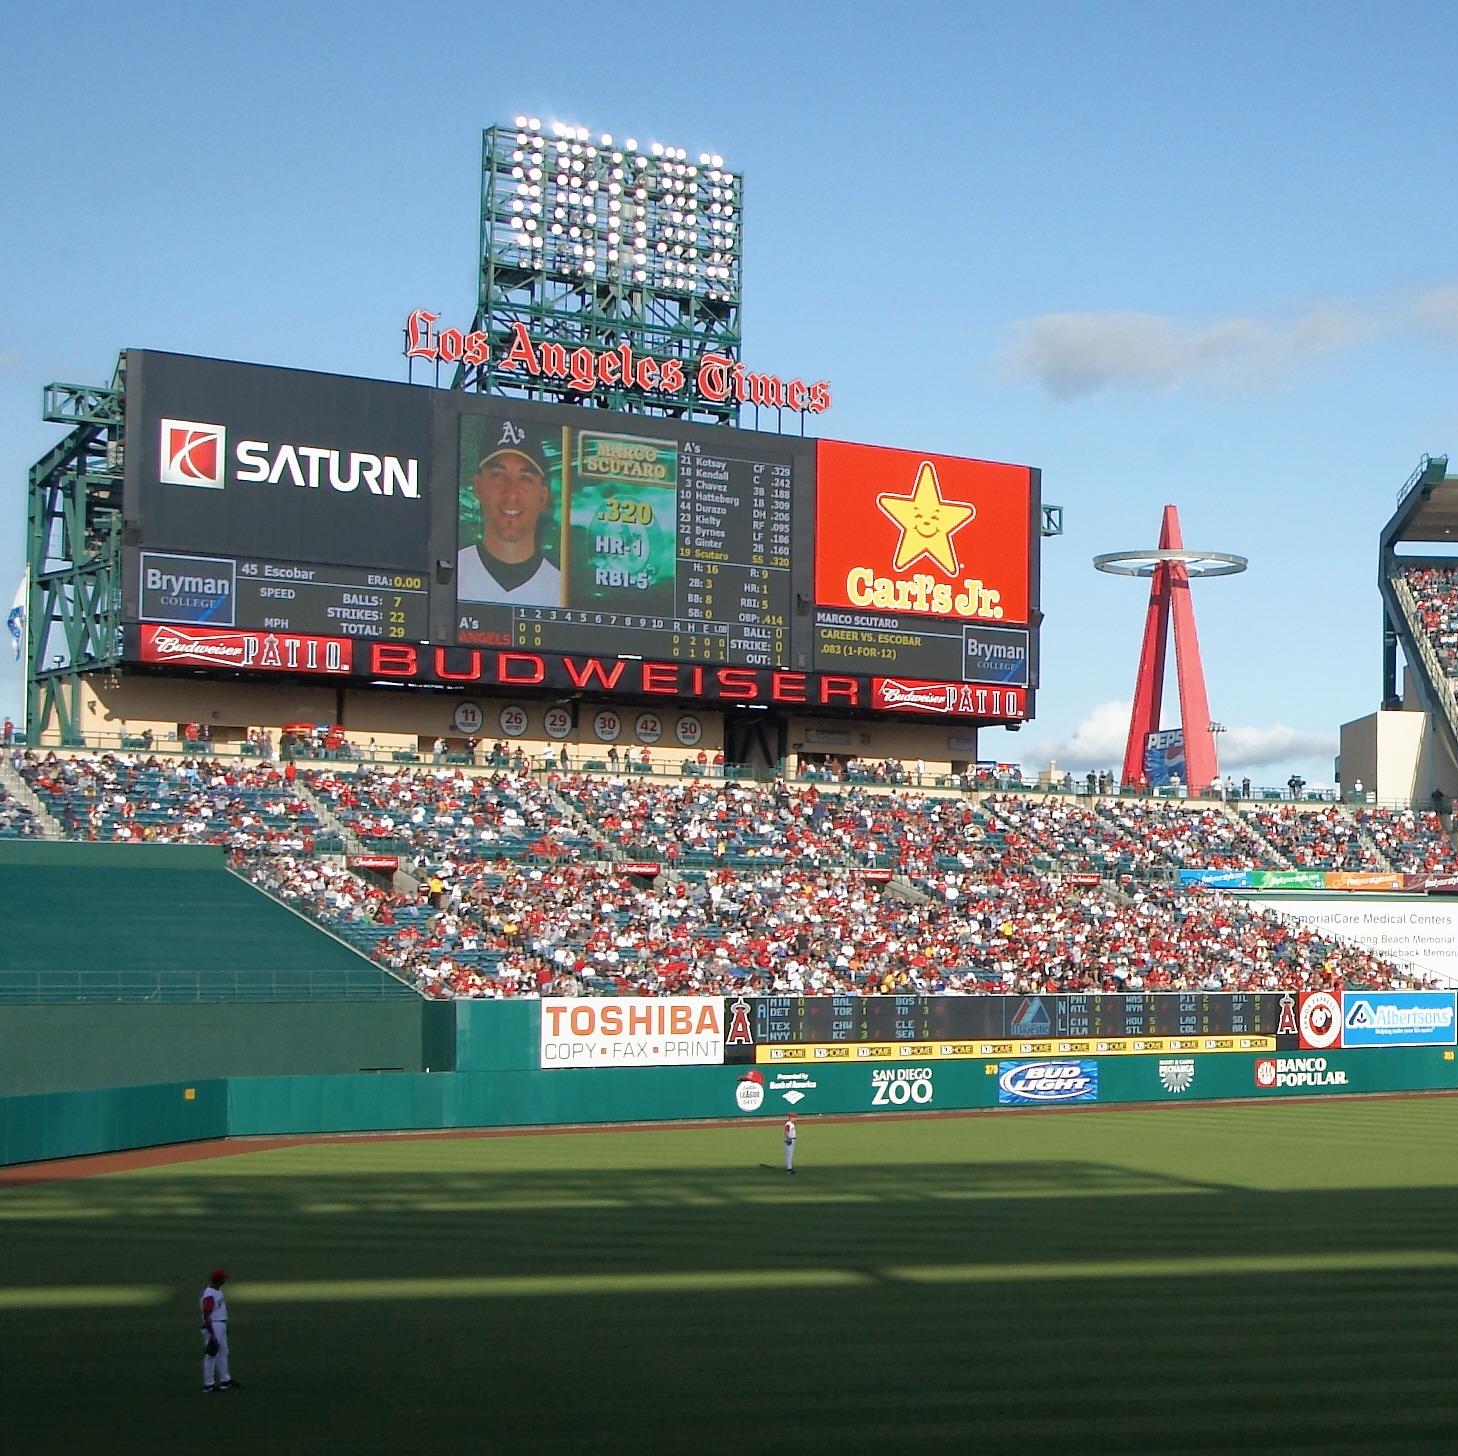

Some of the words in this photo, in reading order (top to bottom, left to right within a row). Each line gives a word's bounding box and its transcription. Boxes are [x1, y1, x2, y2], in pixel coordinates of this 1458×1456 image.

[406, 309, 489, 365] Los
[499, 322, 687, 392] Angeles
[698, 354, 832, 413] Times
[597, 443, 658, 463] MARCO
[683, 442, 701, 454] A's
[236, 440, 419, 498] SATURN
[587, 459, 667, 480] SCUTARO
[680, 455, 691, 465] 21
[695, 457, 726, 471] Kotsay
[753, 464, 765, 474] CF
[680, 467, 691, 476] 18
[695, 470, 729, 480] Kendall
[753, 475, 760, 484] C
[771, 478, 790, 488] .242
[685, 479, 691, 487] 3
[695, 480, 728, 492] Chavez
[680, 490, 691, 499] 10
[695, 492, 740, 506] Hatteberg
[753, 499, 764, 508] 1B
[597, 497, 654, 527] .320
[680, 502, 691, 511] 44
[695, 503, 727, 515] Durazo
[753, 510, 766, 519] DH
[680, 513, 691, 522] 23
[752, 521, 765, 530] RF
[680, 525, 691, 534] 22
[695, 526, 725, 538] Byrnes
[752, 532, 764, 541] LF
[596, 535, 642, 558] HR-1
[685, 537, 691, 545] 6
[695, 538, 722, 549] Ginter
[680, 548, 691, 557] 19
[694, 549, 729, 561] Scutaro
[241, 563, 258, 576] 45
[264, 565, 315, 580] Escobar
[693, 563, 704, 573] H:
[706, 565, 719, 575] 16
[750, 568, 760, 578] R:
[762, 570, 769, 579] 9
[147, 567, 230, 597] Bryman
[367, 574, 392, 587] ERA:
[393, 577, 421, 590] 0.00
[596, 568, 649, 591] RBI-5
[705, 579, 712, 589] 3
[744, 583, 760, 593] HR:
[762, 585, 768, 595] 1
[260, 587, 296, 600] SPEED
[342, 593, 383, 607] BALLS:
[393, 597, 402, 608] 7
[847, 566, 952, 614] Carl's
[955, 578, 1004, 619] Jr.
[160, 595, 216, 609] COLLEGE
[705, 595, 712, 604] 8
[762, 600, 769, 610] 5
[264, 617, 289, 630] MPH
[327, 607, 383, 622] STRIKES:
[389, 611, 405, 624] 22
[459, 616, 480, 630] A's
[688, 608, 703, 618] SB:
[705, 609, 712, 619] 0
[739, 613, 760, 623] OBP:
[762, 615, 783, 626] .414
[817, 612, 852, 625] MARCO
[854, 615, 899, 628] SCUTARO
[341, 623, 383, 637] TOTAL:
[389, 626, 405, 638] 29
[458, 631, 511, 646] ANGELS
[743, 627, 771, 639] BALL:
[775, 628, 783, 639] 0
[820, 629, 859, 642] CAREER
[861, 632, 876, 643] VS.
[878, 634, 922, 647] ESCOBAR
[156, 635, 243, 656] Budweiser
[243, 633, 342, 671] PATIO
[730, 639, 771, 652] STRIKE:
[775, 641, 783, 652] 0
[820, 644, 841, 655] .083
[843, 645, 897, 660] (1-FOR-12)
[968, 638, 1025, 662] Bryman
[746, 654, 771, 665] OUT:
[775, 655, 782, 666] 1
[976, 660, 1017, 672] COLLEGE
[370, 642, 860, 707] BUDWEISER
[883, 685, 947, 704] Budweiser
[945, 684, 1018, 716] PATIO
[462, 708, 476, 721] 11
[506, 711, 523, 724] 26
[550, 713, 567, 726] 29
[600, 717, 616, 730] 30
[640, 719, 657, 732] 42
[681, 722, 697, 735] 50
[1148, 732, 1184, 750] PEPS
[1364, 913, 1406, 925] Medical
[1410, 913, 1453, 926] Centers
[1381, 934, 1411, 945] Beach
[1413, 934, 1456, 945] Memorial
[833, 1007, 852, 1016] TOR
[1377, 1006, 1453, 1027] Albertsons
[546, 1005, 720, 1036] TOSHIBA
[770, 1021, 790, 1031] TEX
[896, 1020, 915, 1029] CLE
[545, 1042, 597, 1060] COPY
[612, 1041, 648, 1058] FAX
[664, 1040, 720, 1058] PRINT
[1025, 1066, 1082, 1080] BUD
[1276, 1058, 1327, 1072] BANCO
[872, 1070, 891, 1081] SAN
[896, 1068, 933, 1081] DIEGO
[1014, 1078, 1091, 1091] LIGHT
[872, 1080, 933, 1106] ZOO
